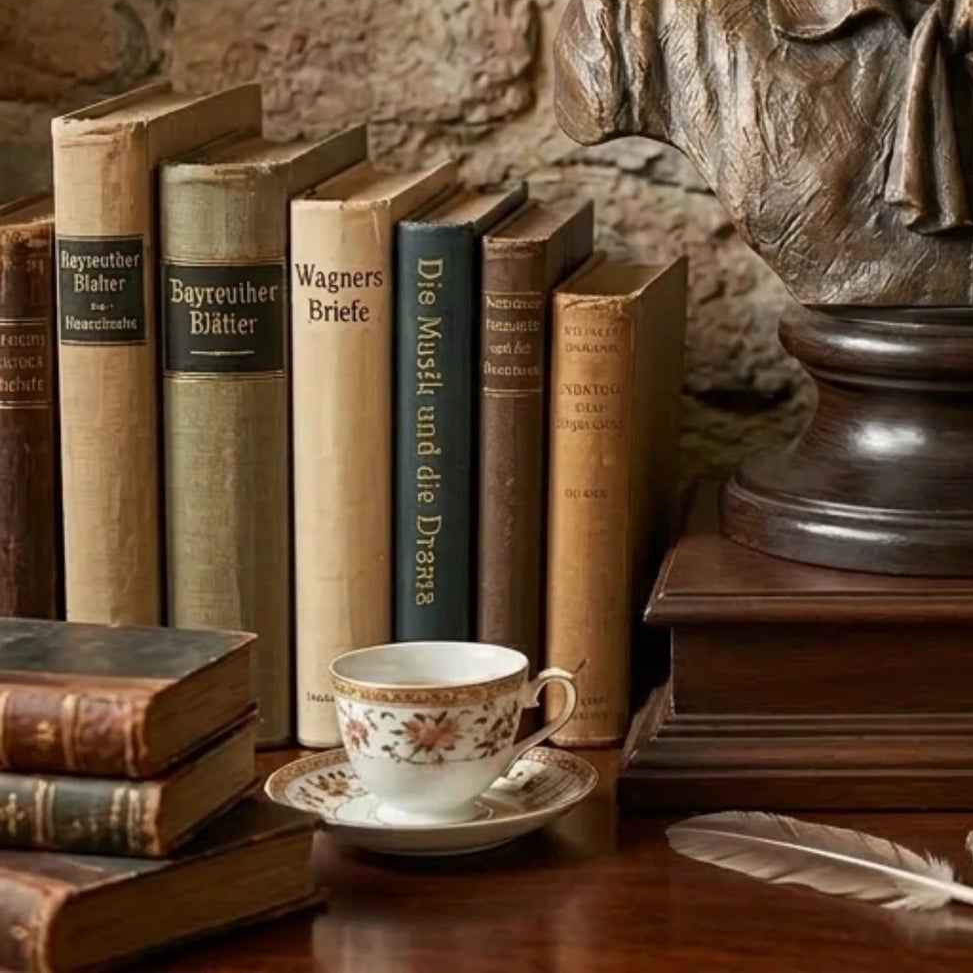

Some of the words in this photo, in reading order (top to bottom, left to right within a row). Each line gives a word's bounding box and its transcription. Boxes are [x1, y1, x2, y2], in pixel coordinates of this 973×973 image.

[295, 263, 384, 294] Wagners
[417, 257, 444, 306] Die
[308, 297, 370, 323] Briefe
